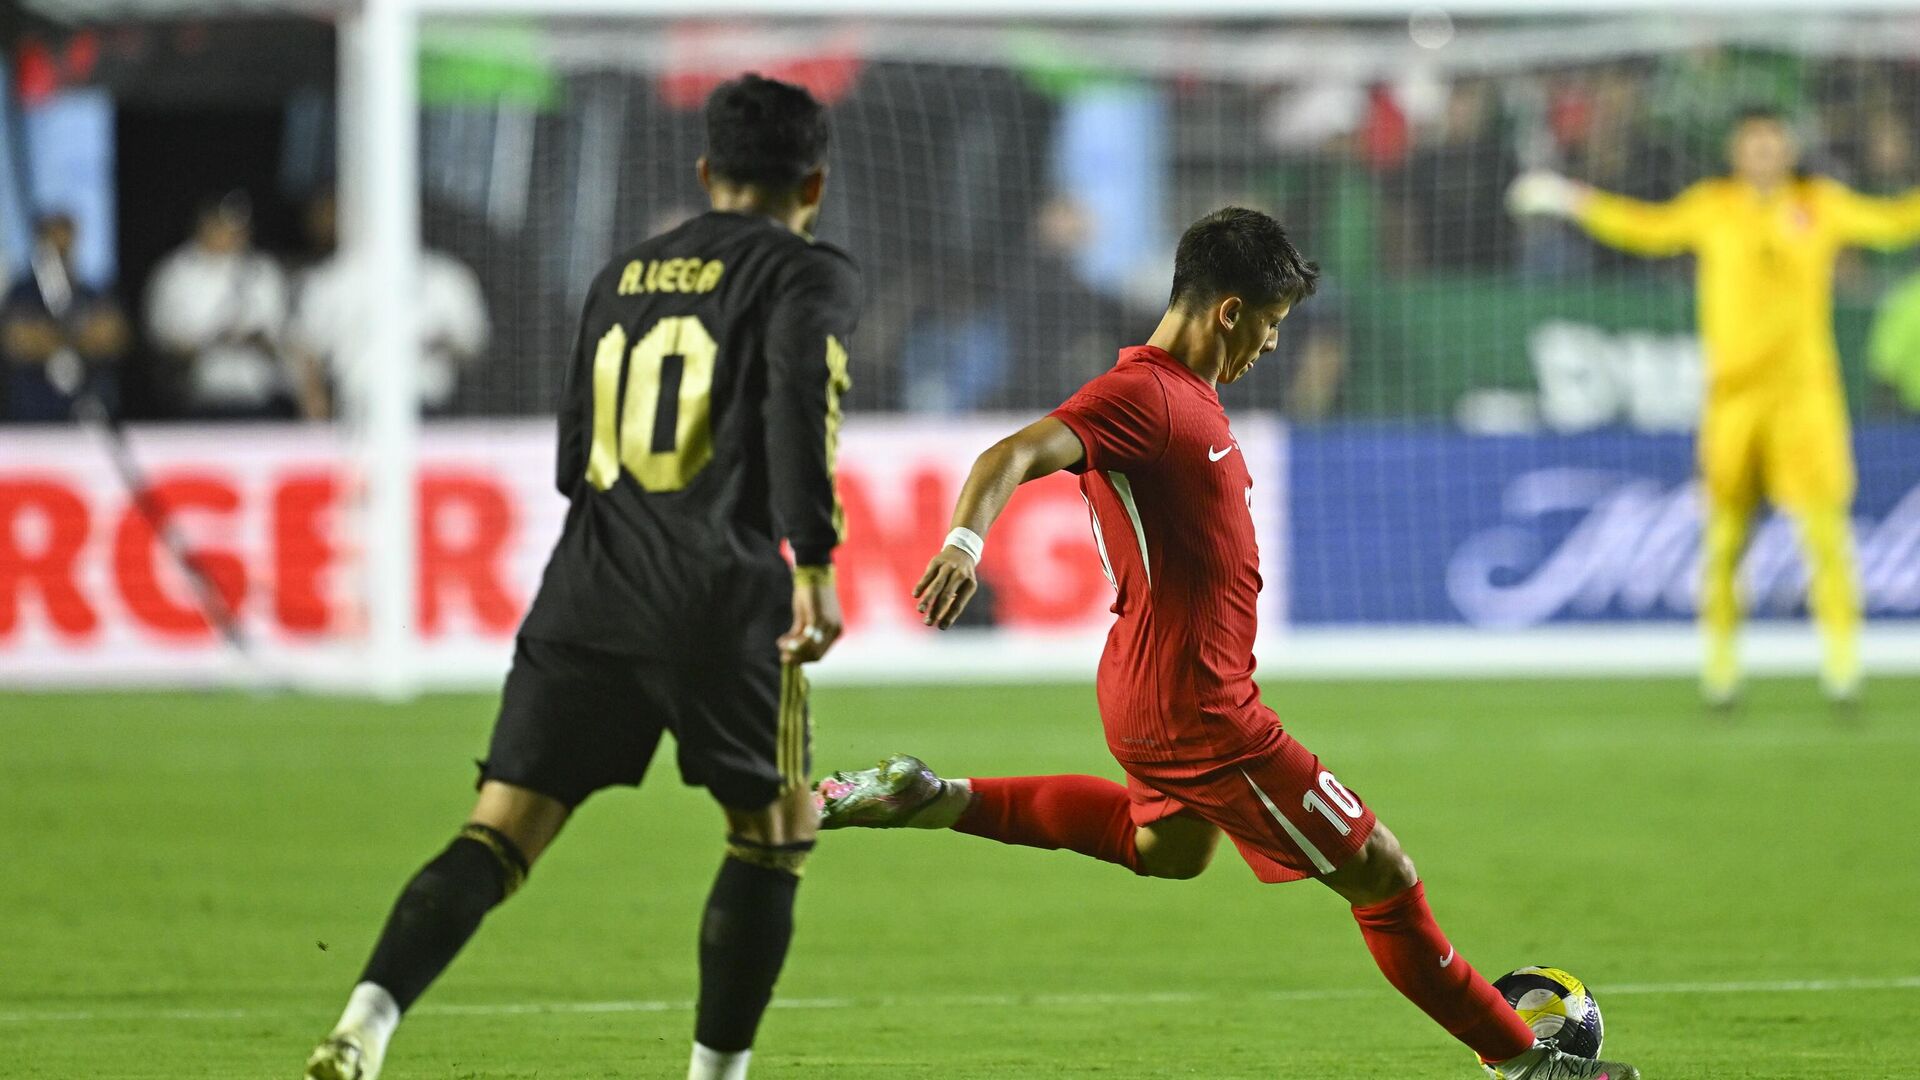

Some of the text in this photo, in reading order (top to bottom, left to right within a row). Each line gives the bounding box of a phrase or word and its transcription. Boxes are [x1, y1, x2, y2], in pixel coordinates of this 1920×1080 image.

[585, 315, 718, 492] 10
[836, 468, 1108, 632] NG
[1302, 770, 1363, 837] 10
